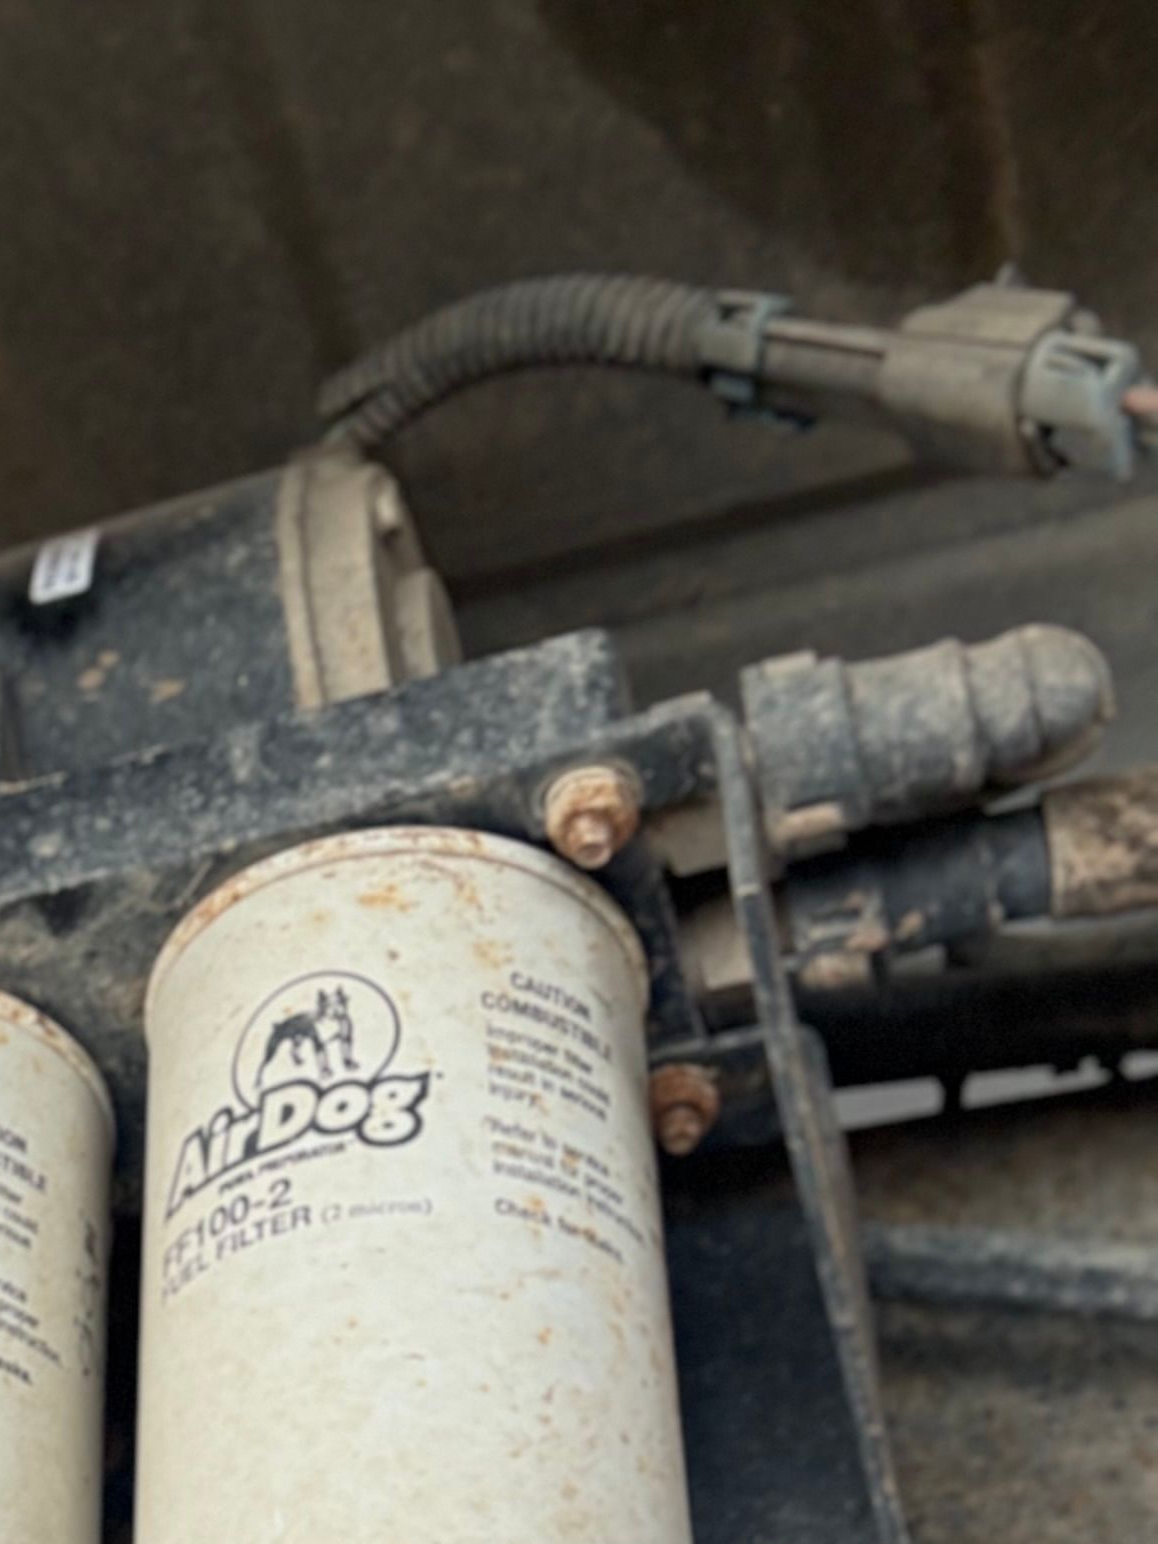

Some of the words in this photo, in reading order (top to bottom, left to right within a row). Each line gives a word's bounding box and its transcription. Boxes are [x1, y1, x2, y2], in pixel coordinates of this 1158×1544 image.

[510, 971, 591, 1021] CAUTION
[164, 1070, 430, 1225] AirDog
[160, 1178, 292, 1282] FF100-2
[214, 1203, 313, 1261] FILTER
